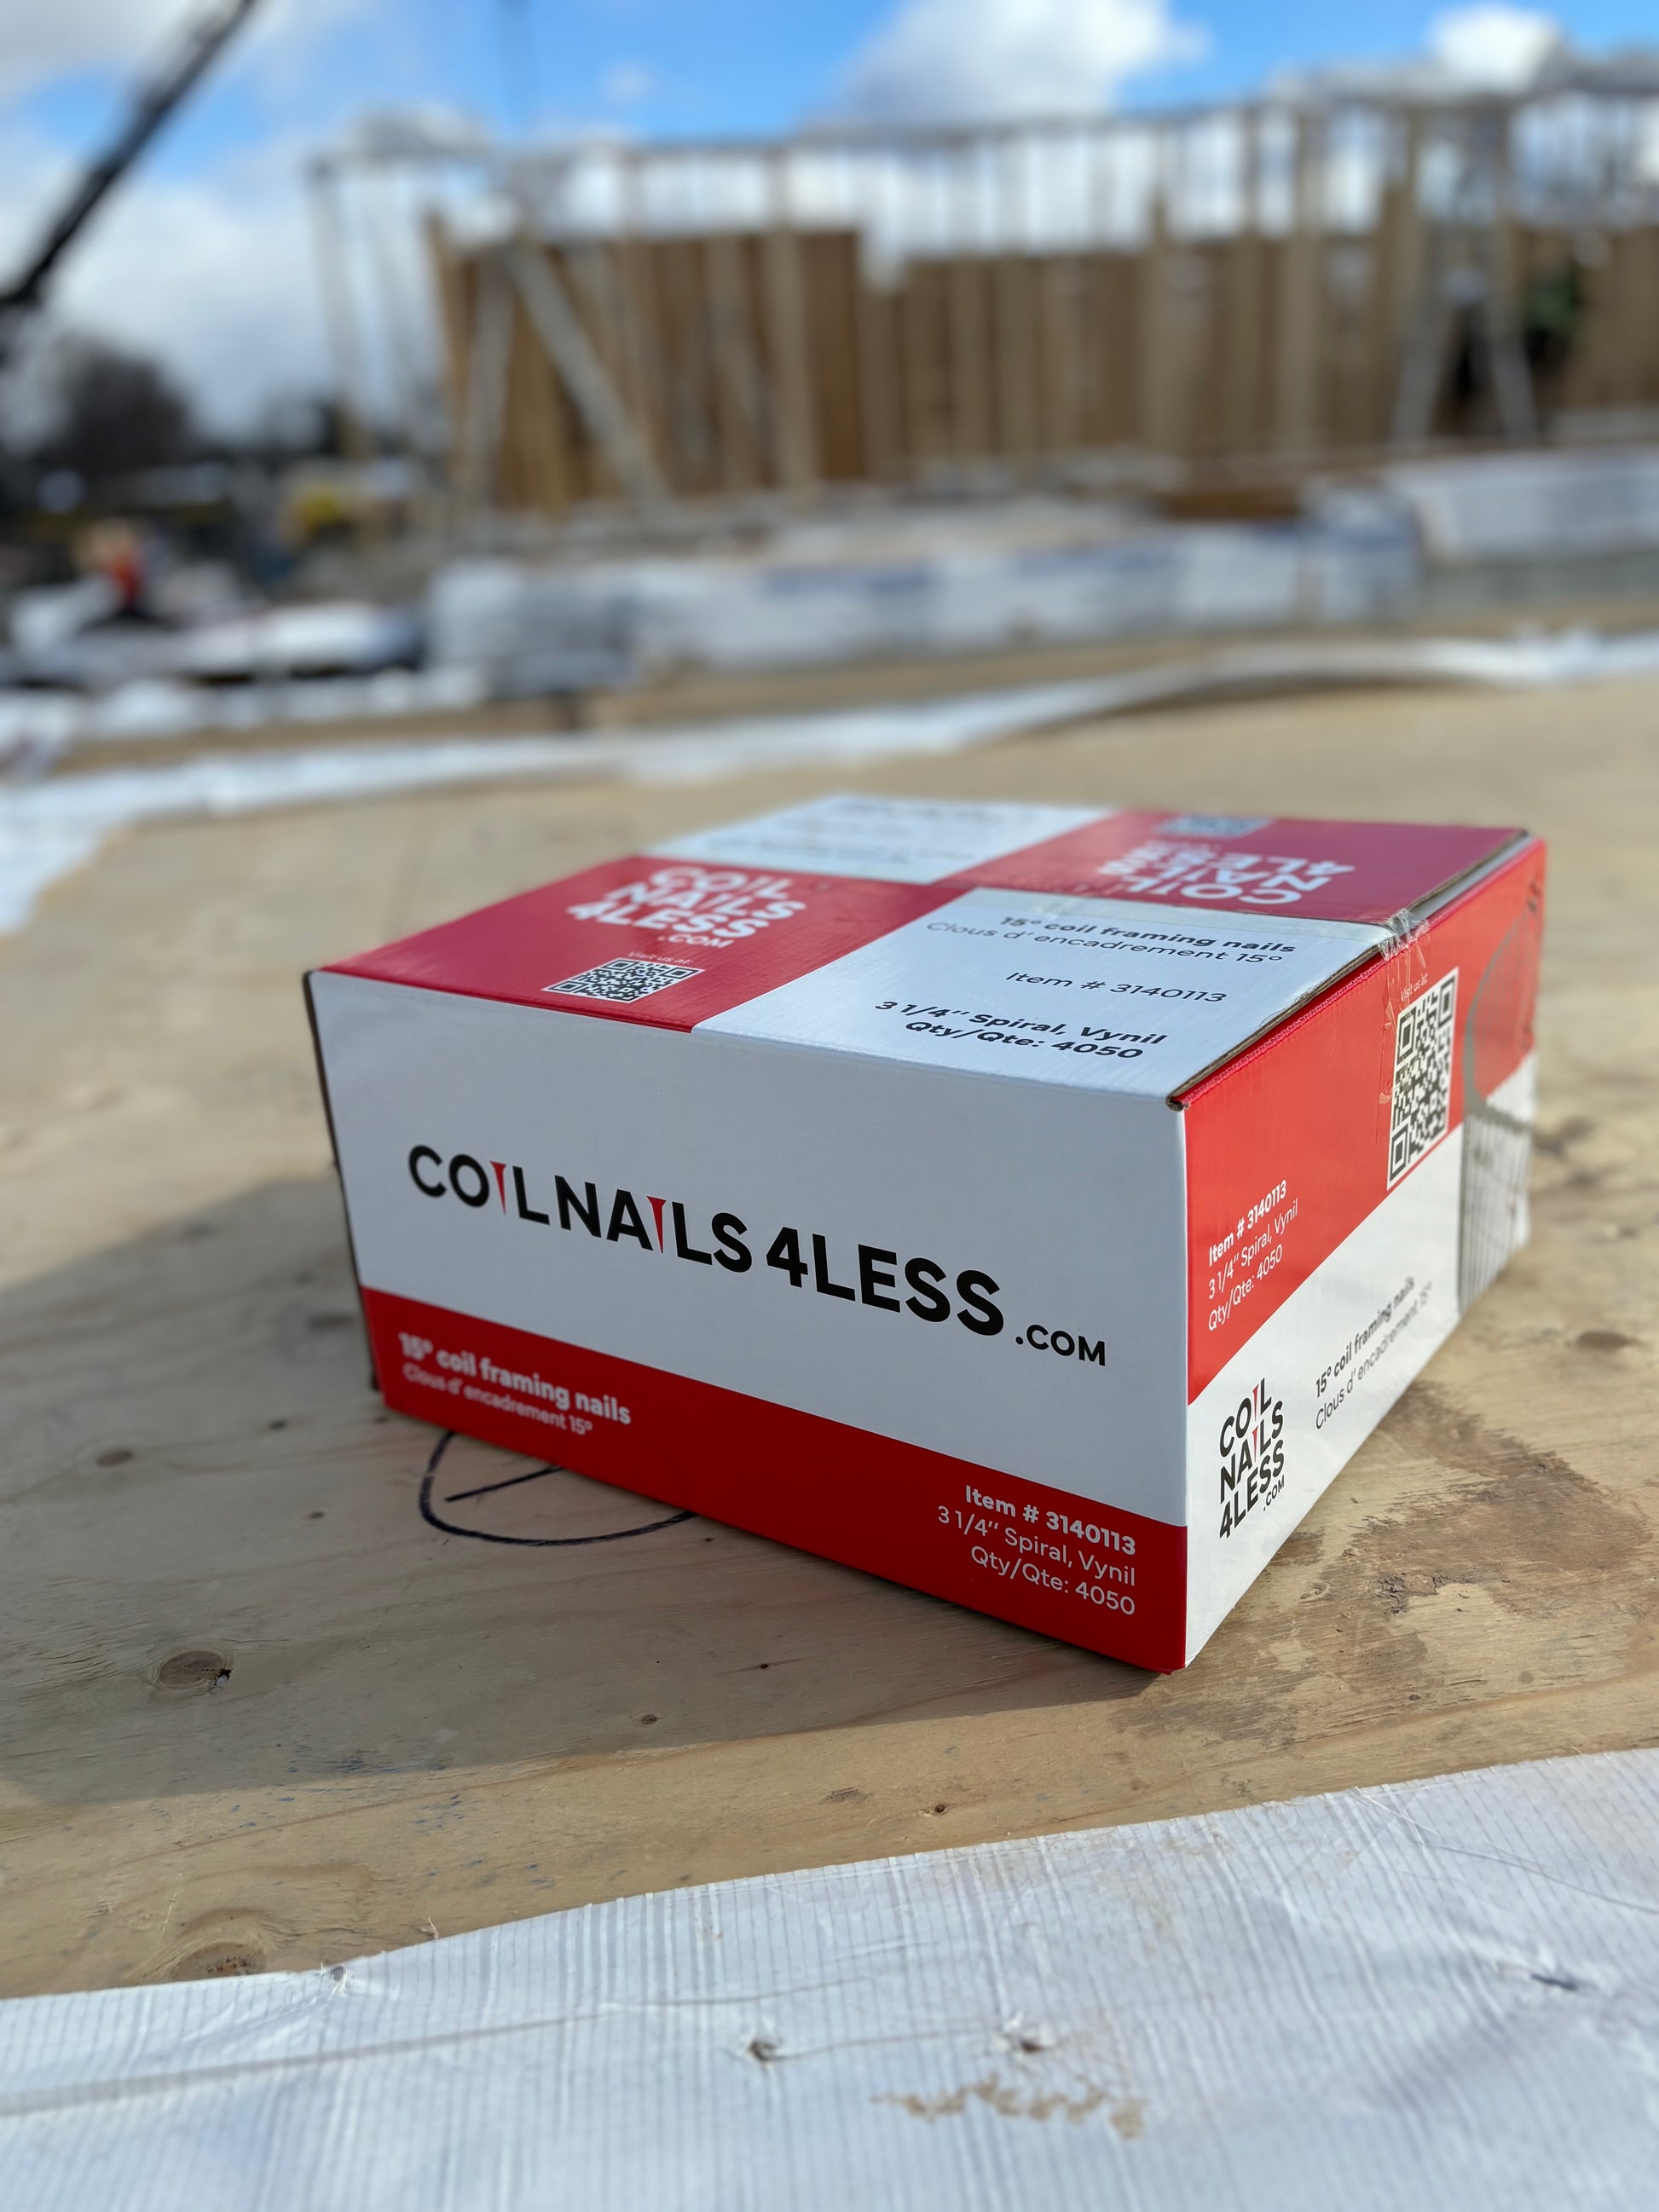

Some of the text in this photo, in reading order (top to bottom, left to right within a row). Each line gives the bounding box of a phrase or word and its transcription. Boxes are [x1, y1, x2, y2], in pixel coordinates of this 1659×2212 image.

[604, 881, 807, 920] NAILS
[650, 865, 793, 899] COIL
[1121, 876, 1302, 904] COIL
[566, 900, 769, 939] 4LESS
[927, 921, 997, 937] Clous
[1235, 953, 1283, 963] 15°
[1044, 922, 1098, 934] coil
[1099, 927, 1217, 947] framing
[1222, 940, 1297, 953] nails
[1005, 972, 1228, 1003] Item # 3140113
[875, 1001, 898, 1011] 3
[968, 1014, 1067, 1036] Spiral,
[1080, 1026, 1168, 1045] Vynil
[905, 1021, 1144, 1059] Qty/Qte: 4050
[1208, 1278, 1215, 1300] 3
[1240, 1223, 1271, 1267] Spiral,
[1274, 1197, 1298, 1235] Vynil
[1209, 1179, 1286, 1268] Item # 3140113
[1208, 1244, 1282, 1331] Qty/Qte: 4050
[1315, 1366, 1332, 1398] 15°
[1333, 1342, 1352, 1377] coil
[1354, 1302, 1392, 1354] framing
[402, 1362, 446, 1391] Clous
[569, 1414, 592, 1435] 15°
[436, 1349, 477, 1377] coil
[479, 1356, 570, 1411] framing
[575, 1391, 631, 1424] nails
[1219, 1377, 1272, 1458] COIL
[1315, 1388, 1344, 1429] Clous
[1220, 1400, 1284, 1505] NAILS
[964, 1485, 1136, 1556] Item # 3140113
[1219, 1439, 1285, 1539] 4LESS
[1263, 1474, 1285, 1512] .COM
[937, 1505, 950, 1525] 3
[1004, 1527, 1073, 1568] Spiral,
[1078, 1550, 1136, 1587] Vynil
[970, 1545, 1136, 1615] Qty/Qte: 4050
